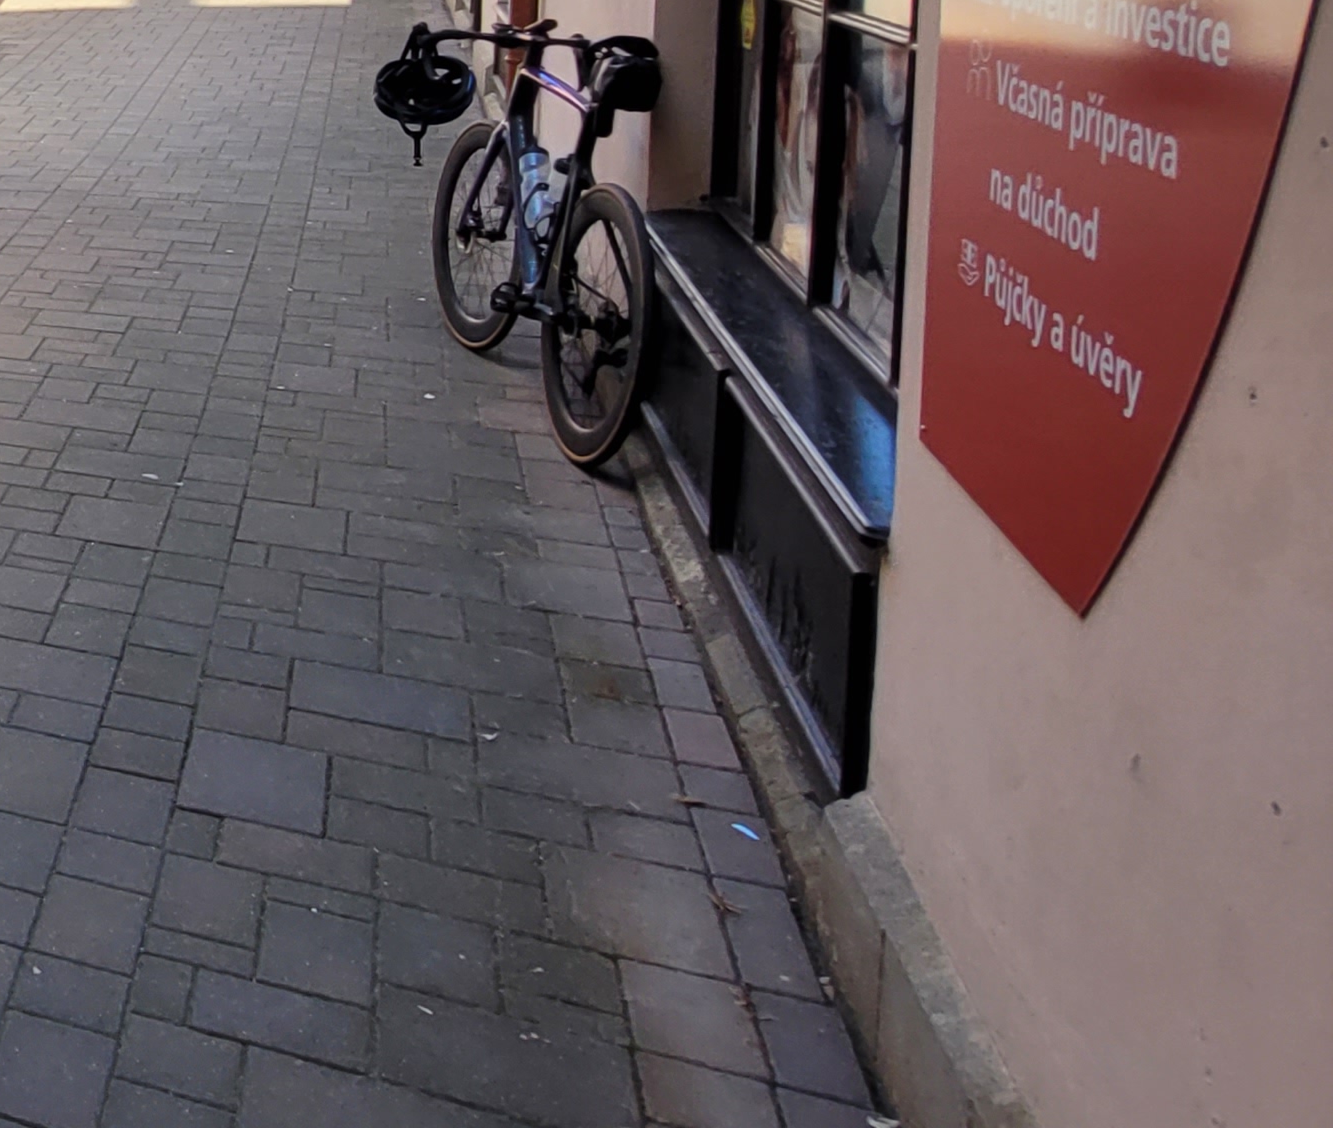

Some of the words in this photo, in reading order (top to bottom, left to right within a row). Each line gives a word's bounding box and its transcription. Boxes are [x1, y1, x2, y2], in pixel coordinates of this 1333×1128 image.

[996, 59, 1064, 131] Včasná
[1068, 89, 1178, 180] příprava
[989, 168, 1014, 212] na
[1017, 172, 1100, 261] důchod
[984, 253, 1047, 348] Půjčky
[1050, 312, 1064, 352] a
[1071, 314, 1143, 418] úvěry
